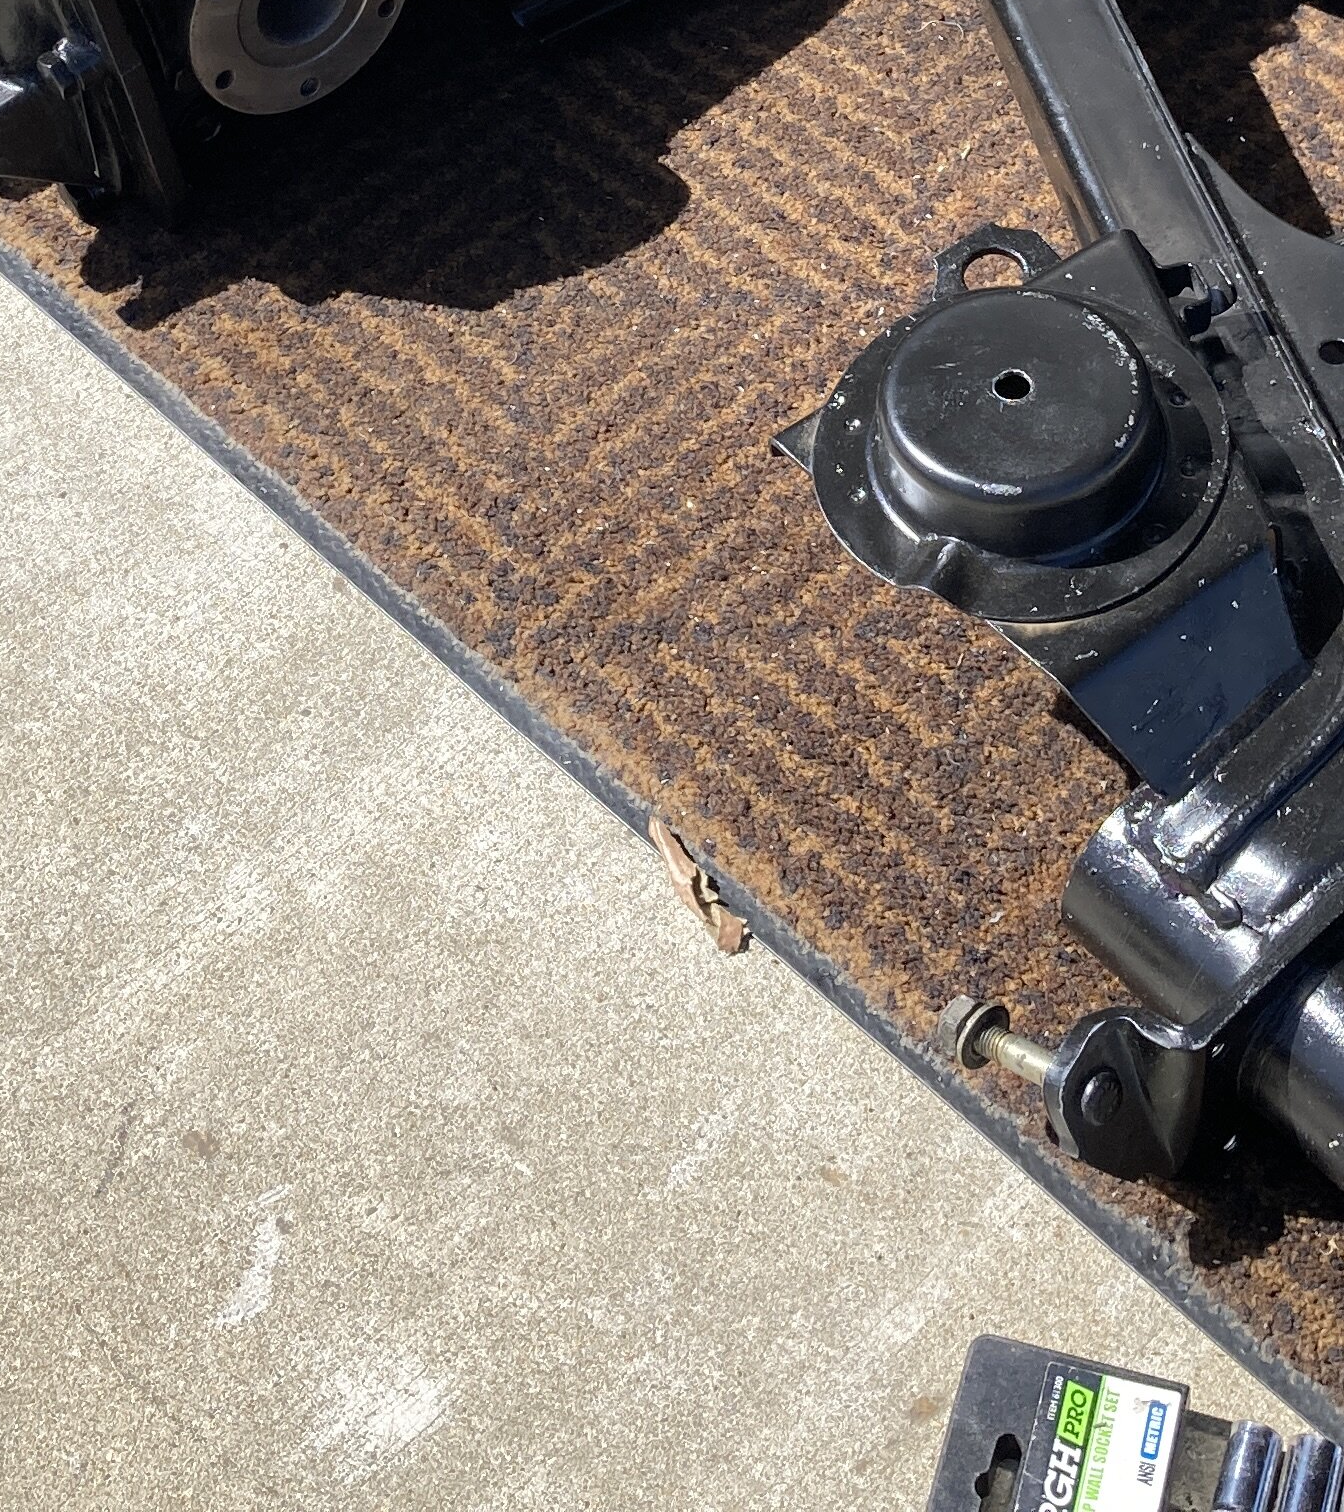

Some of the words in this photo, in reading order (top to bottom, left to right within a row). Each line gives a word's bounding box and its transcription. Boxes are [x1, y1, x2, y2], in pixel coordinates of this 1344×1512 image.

[1046, 1399, 1059, 1421] ITEM
[1063, 1388, 1087, 1440] PRO
[1103, 1388, 1121, 1414] SET
[1092, 1415, 1117, 1463] SOCKET
[1142, 1406, 1165, 1455] METRIC
[1084, 1466, 1105, 1501] WALL
[1137, 1461, 1157, 1487] ANSI
